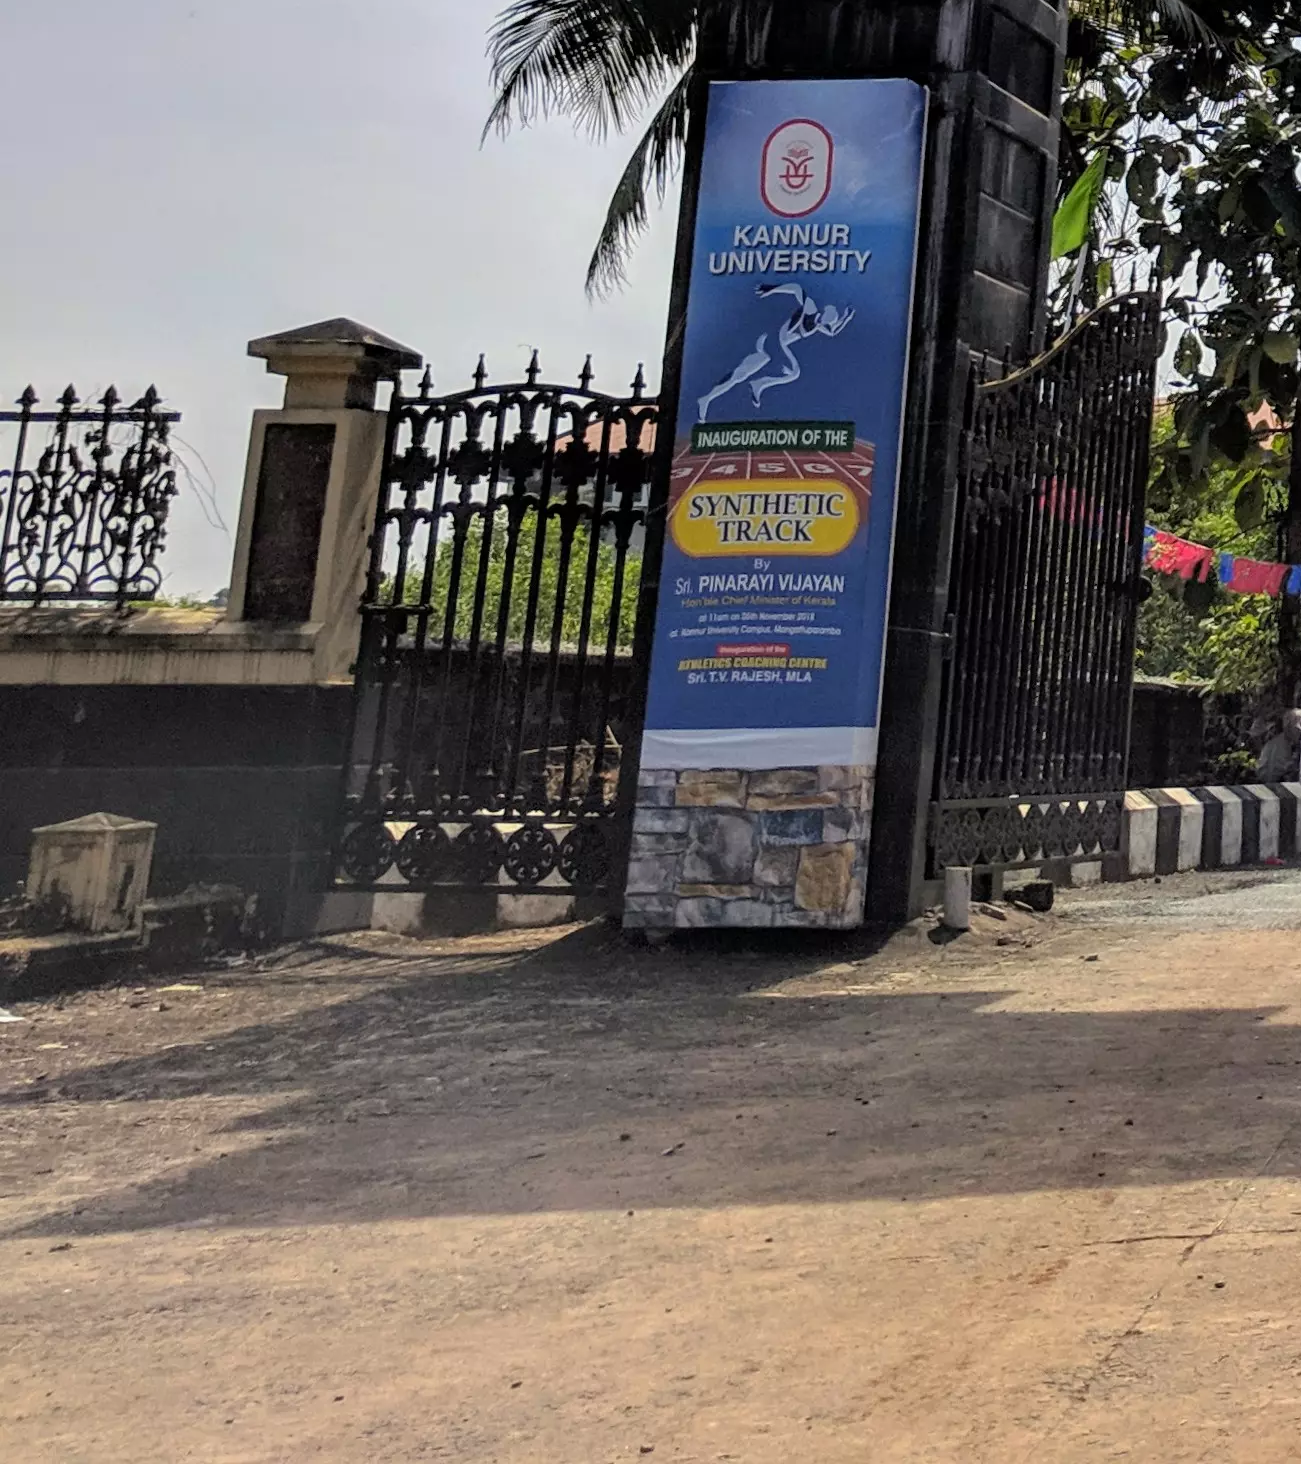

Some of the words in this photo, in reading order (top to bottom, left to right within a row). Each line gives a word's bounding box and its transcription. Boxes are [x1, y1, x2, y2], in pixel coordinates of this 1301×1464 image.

[733, 224, 850, 248] KANNUR
[708, 250, 872, 275] UNIVERSITY
[697, 429, 799, 447] INAUGURATION
[802, 429, 821, 445] OF
[824, 430, 848, 446] THE
[710, 464, 738, 475] 4
[758, 463, 786, 473] 5
[803, 463, 835, 473] 6
[847, 465, 873, 476] 7
[690, 493, 844, 518] SYNTHETIC
[717, 519, 813, 542] TRACK
[754, 559, 770, 571] By
[675, 578, 693, 595] Sri.
[699, 574, 774, 593] PINARAYI
[778, 575, 845, 593] VIJAYAN
[722, 596, 746, 606] Chief
[792, 596, 801, 605] of
[803, 596, 836, 606] Kerala
[786, 671, 812, 682] MLA
